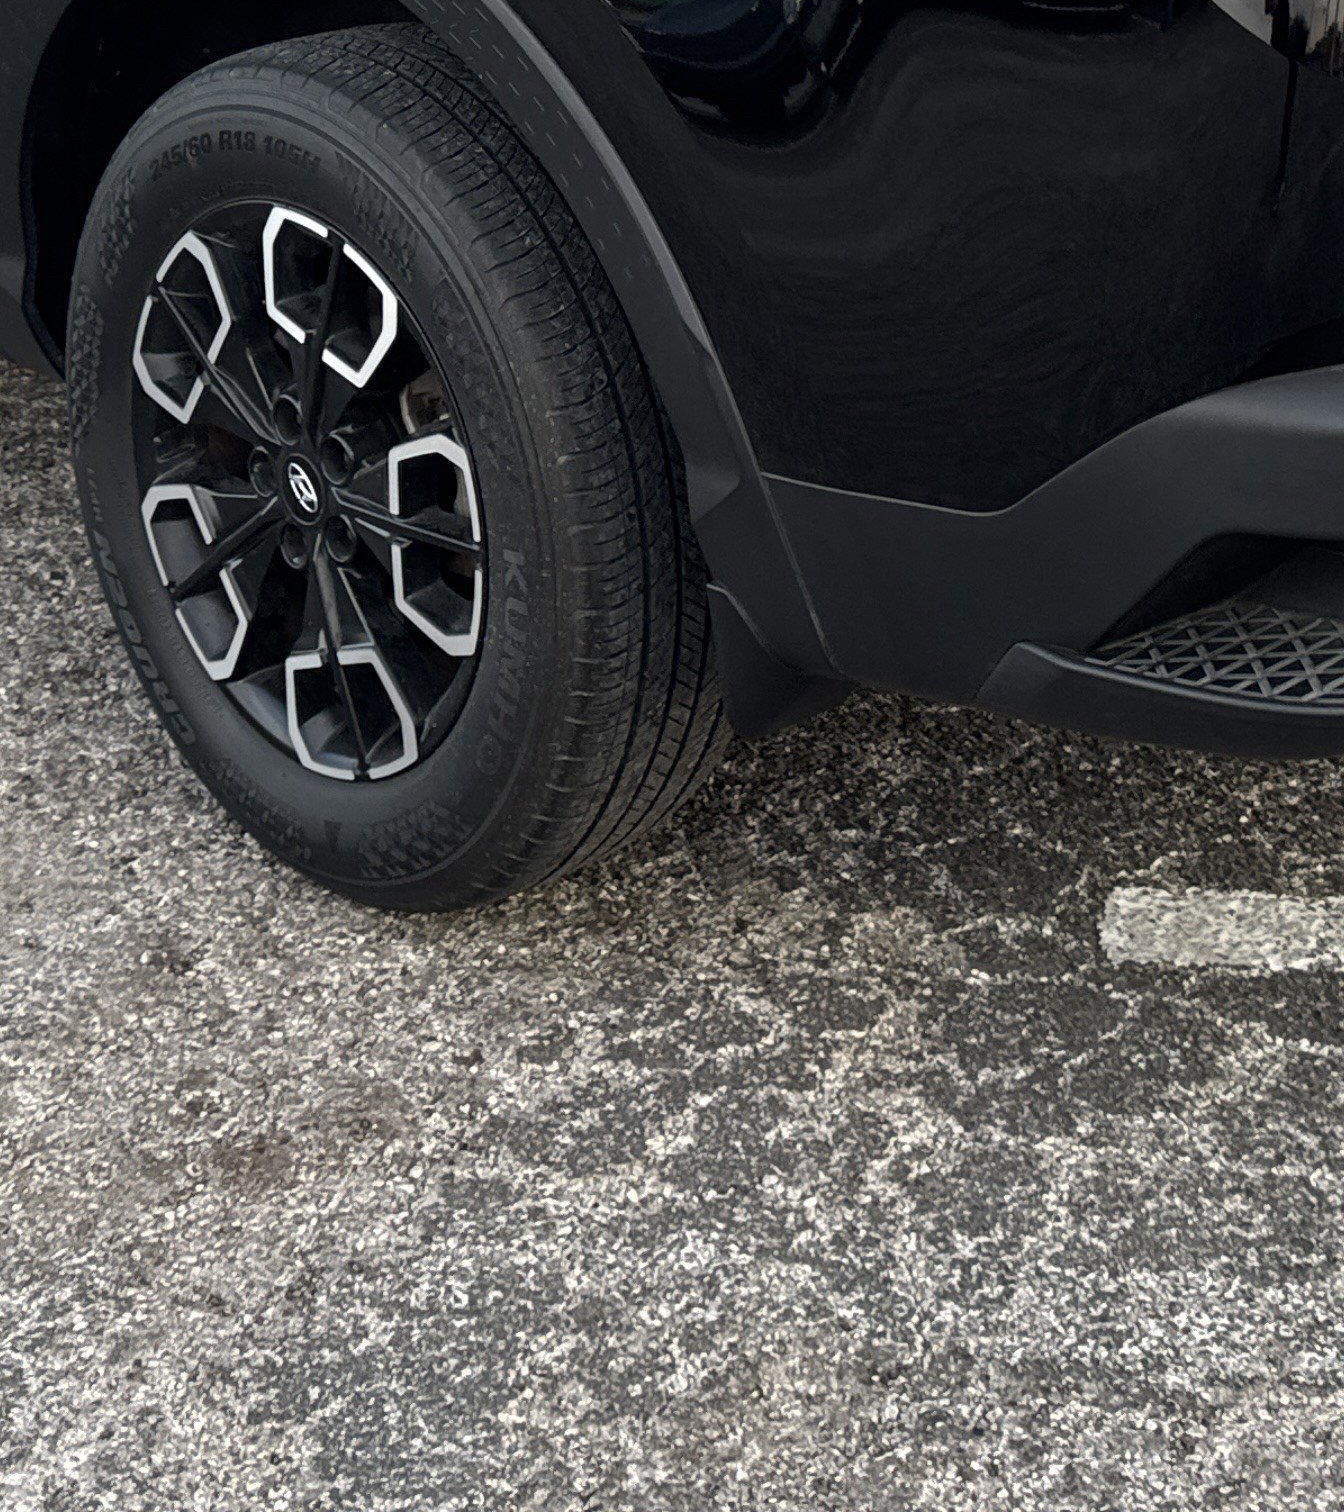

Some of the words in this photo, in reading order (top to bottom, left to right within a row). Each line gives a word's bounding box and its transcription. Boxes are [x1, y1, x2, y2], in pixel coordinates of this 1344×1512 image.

[150, 132, 212, 182] 245/60
[219, 129, 256, 152] R18
[475, 548, 529, 775] KUMHO
